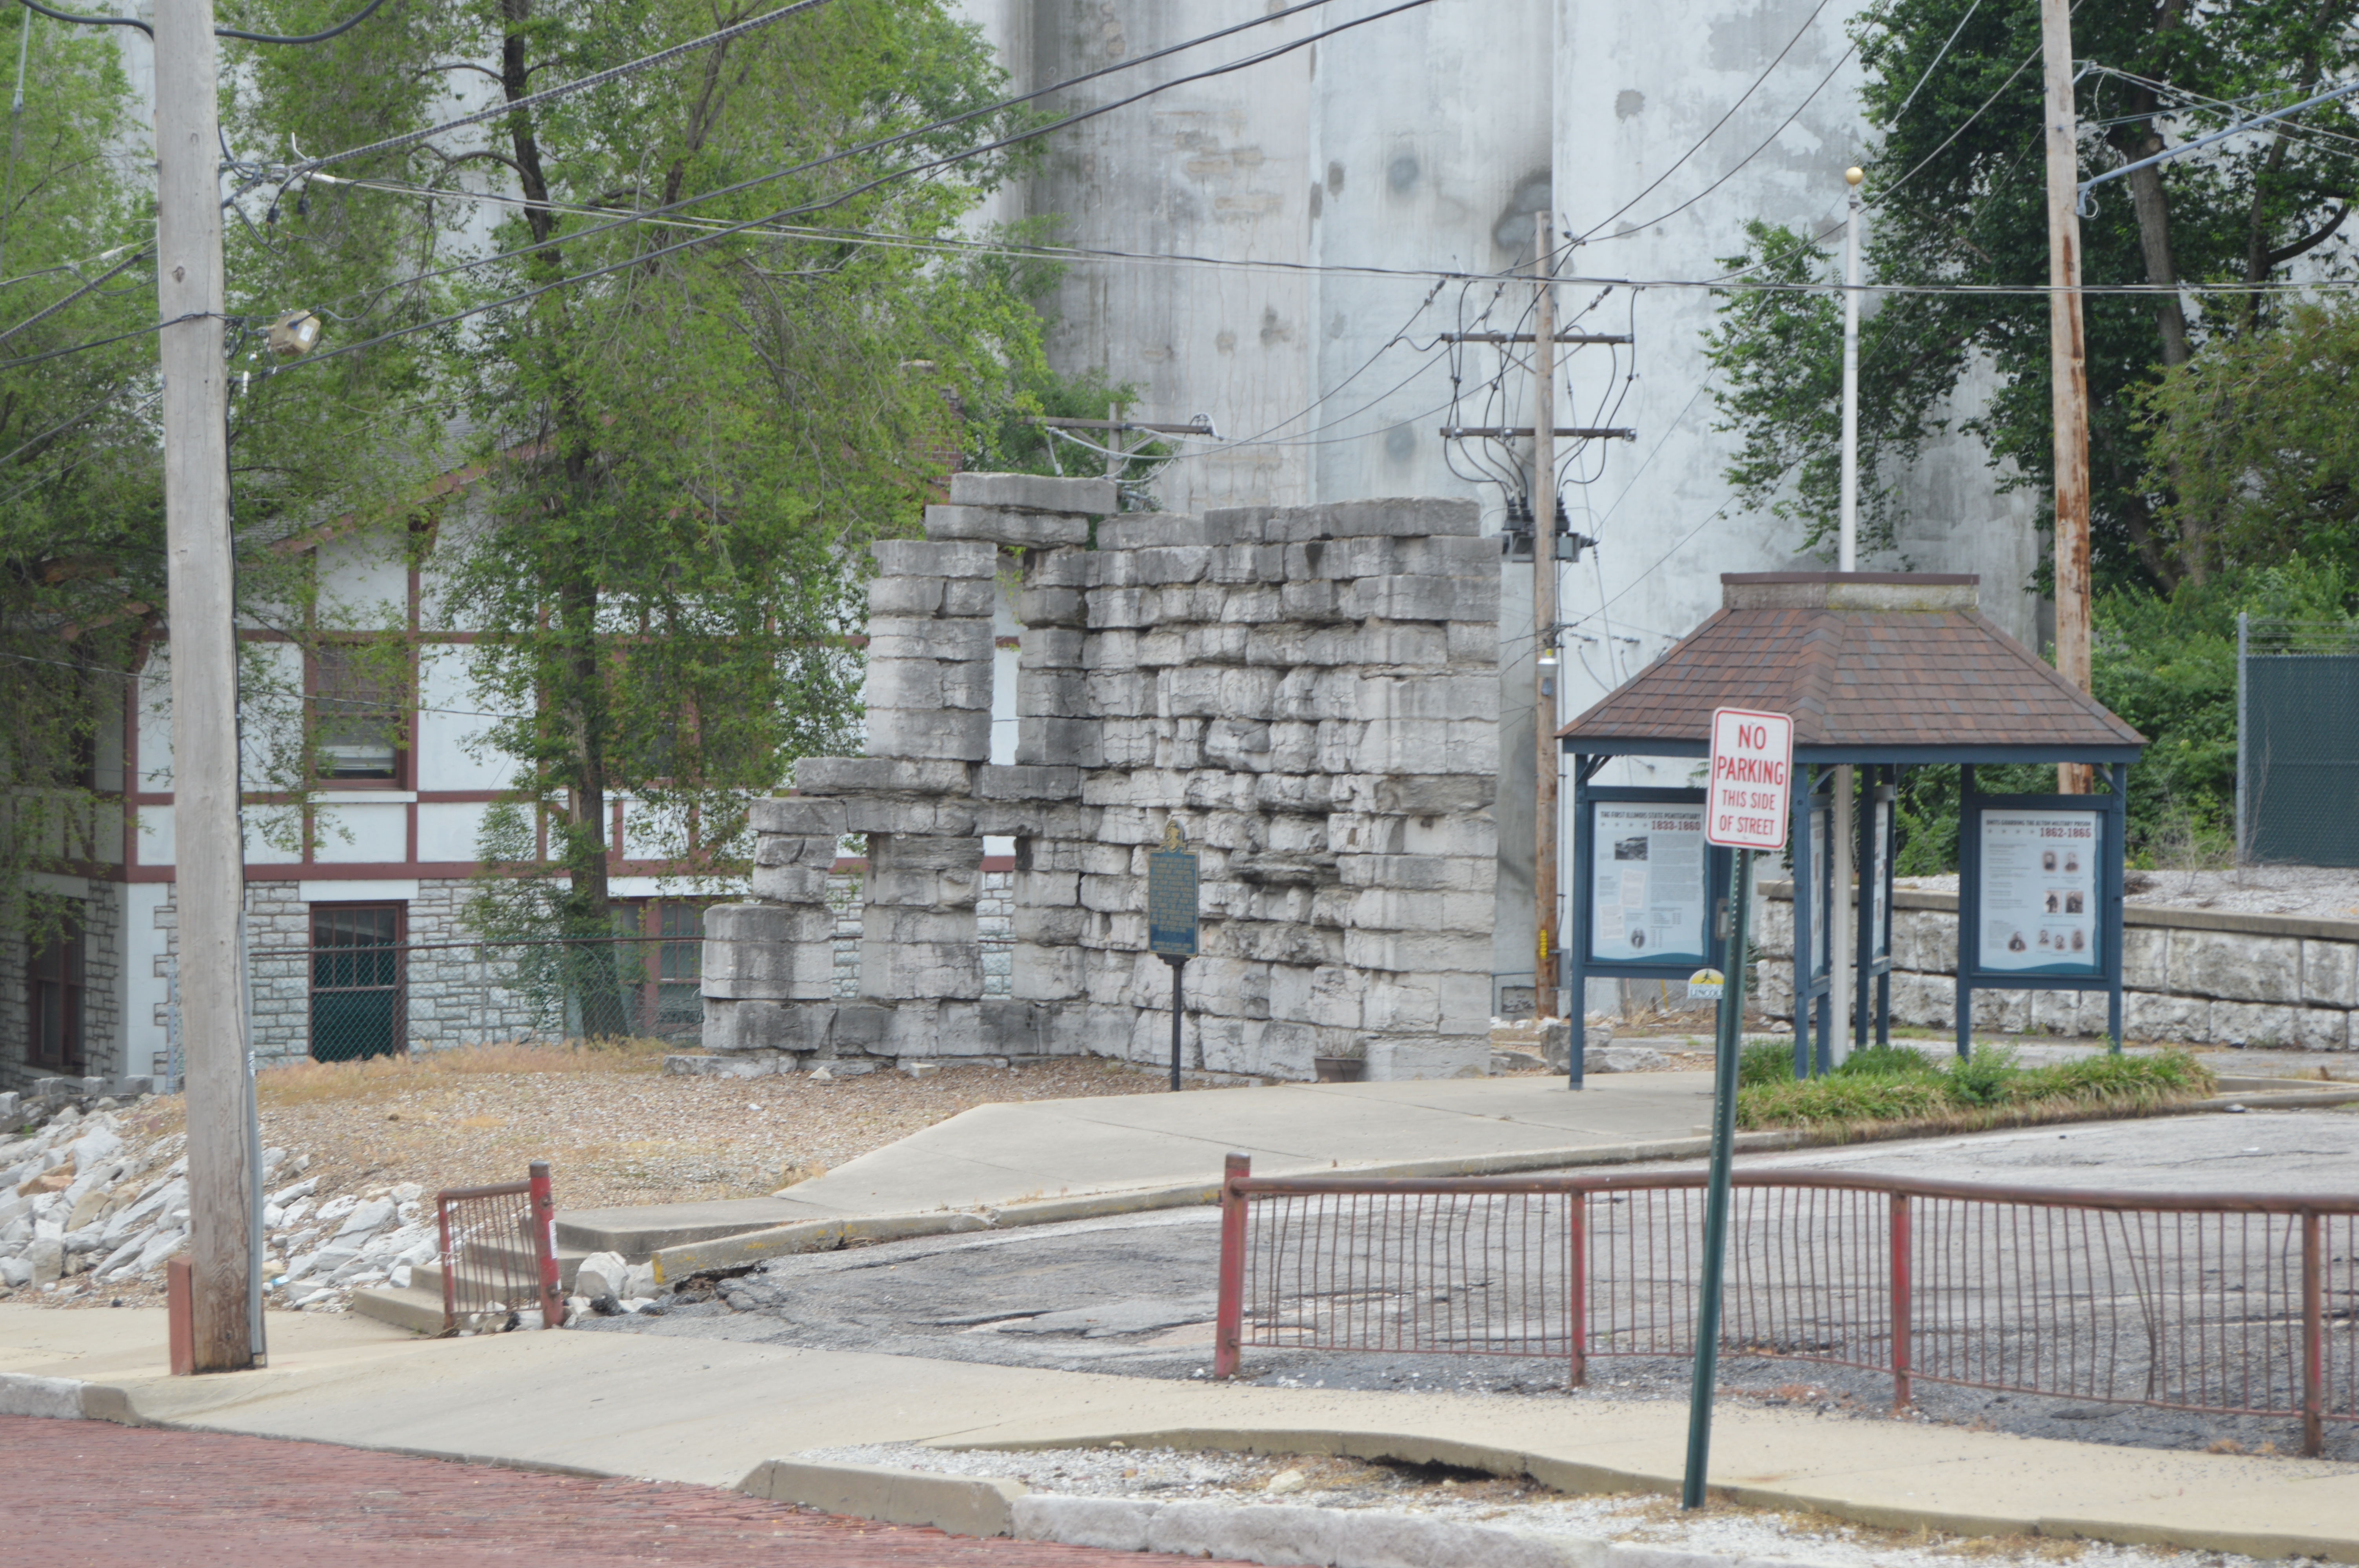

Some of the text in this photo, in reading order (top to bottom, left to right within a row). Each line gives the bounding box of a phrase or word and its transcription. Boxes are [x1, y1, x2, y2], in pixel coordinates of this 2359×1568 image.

[1738, 724, 1767, 750] NO
[1716, 755, 1784, 786] PARKING
[1723, 789, 1776, 810] THIS SIDE
[1651, 820, 1701, 831] 1833-1860
[1720, 815, 1775, 835] OF STREET
[2040, 827, 2092, 838] 1862-1865
